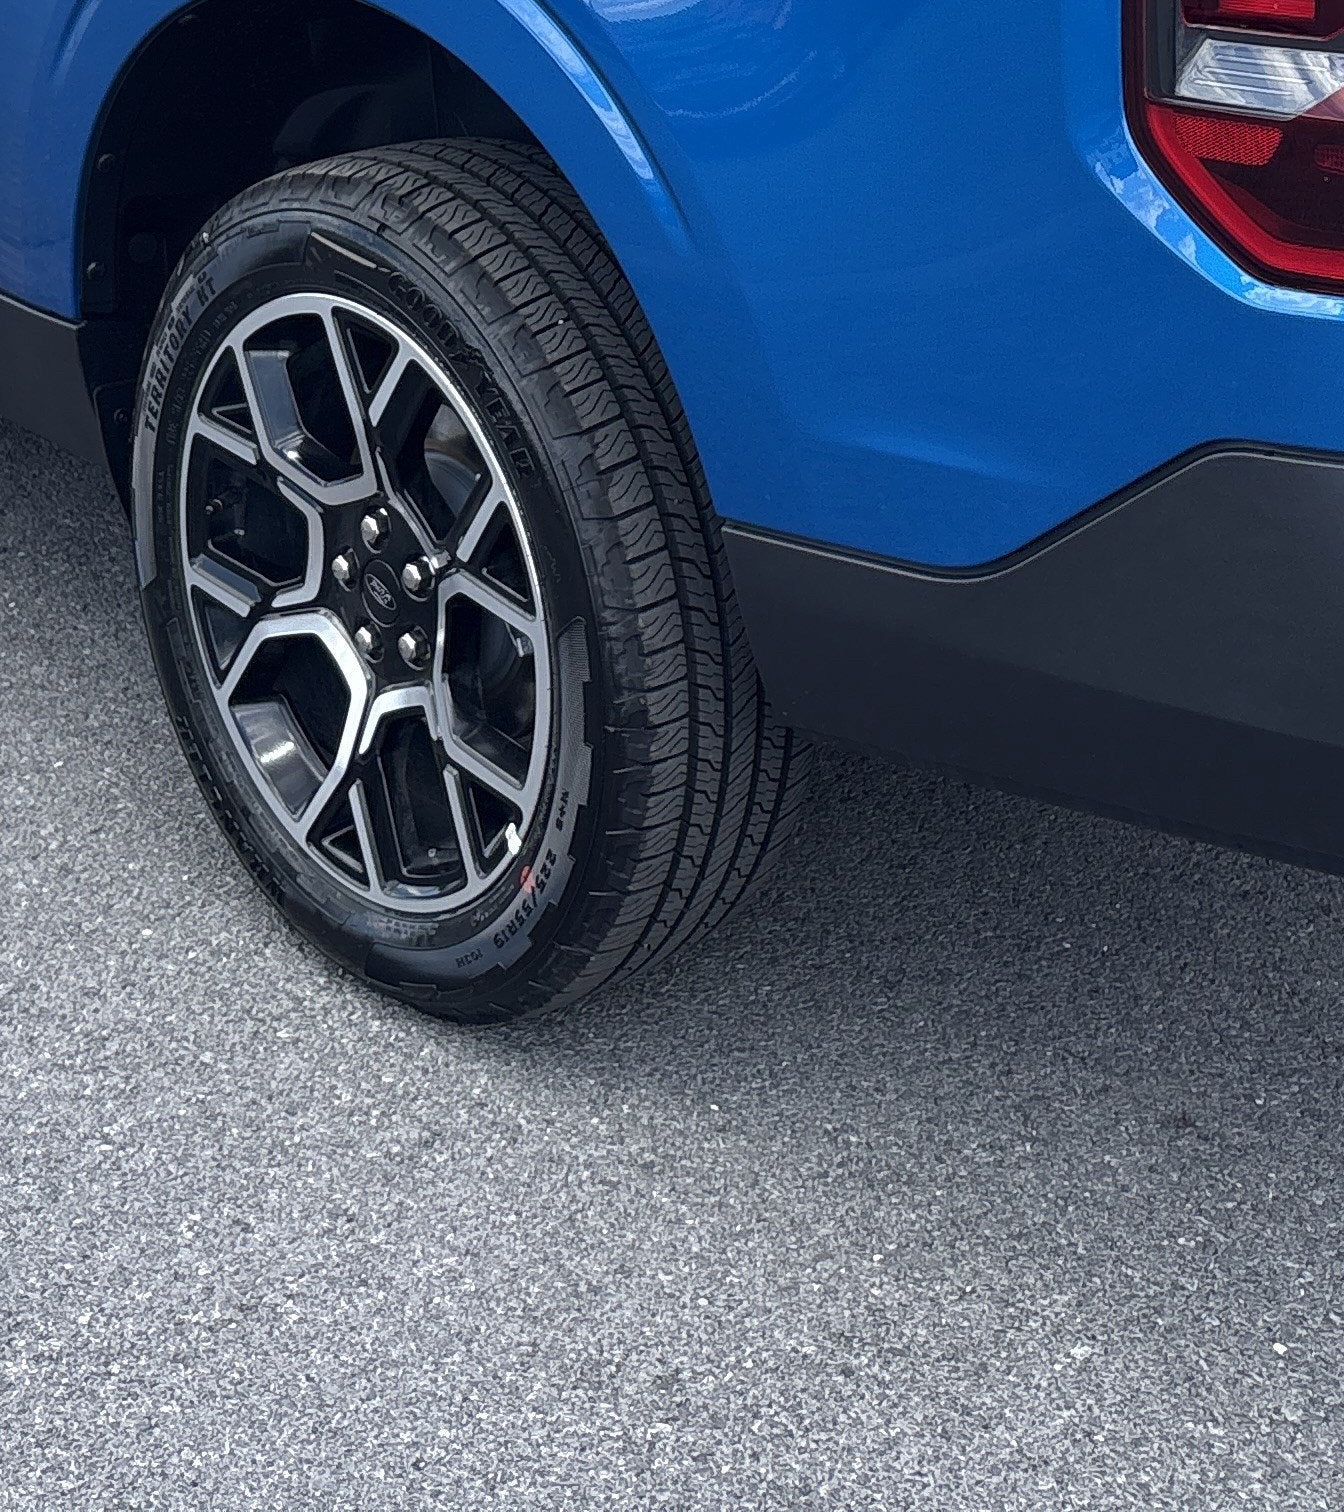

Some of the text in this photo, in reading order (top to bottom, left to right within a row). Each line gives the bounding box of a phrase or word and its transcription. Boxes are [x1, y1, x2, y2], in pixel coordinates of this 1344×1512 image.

[144, 305, 194, 433] TERRITORY
[387, 270, 537, 478] GOODYEAR
[493, 847, 557, 948] 225/55R19
